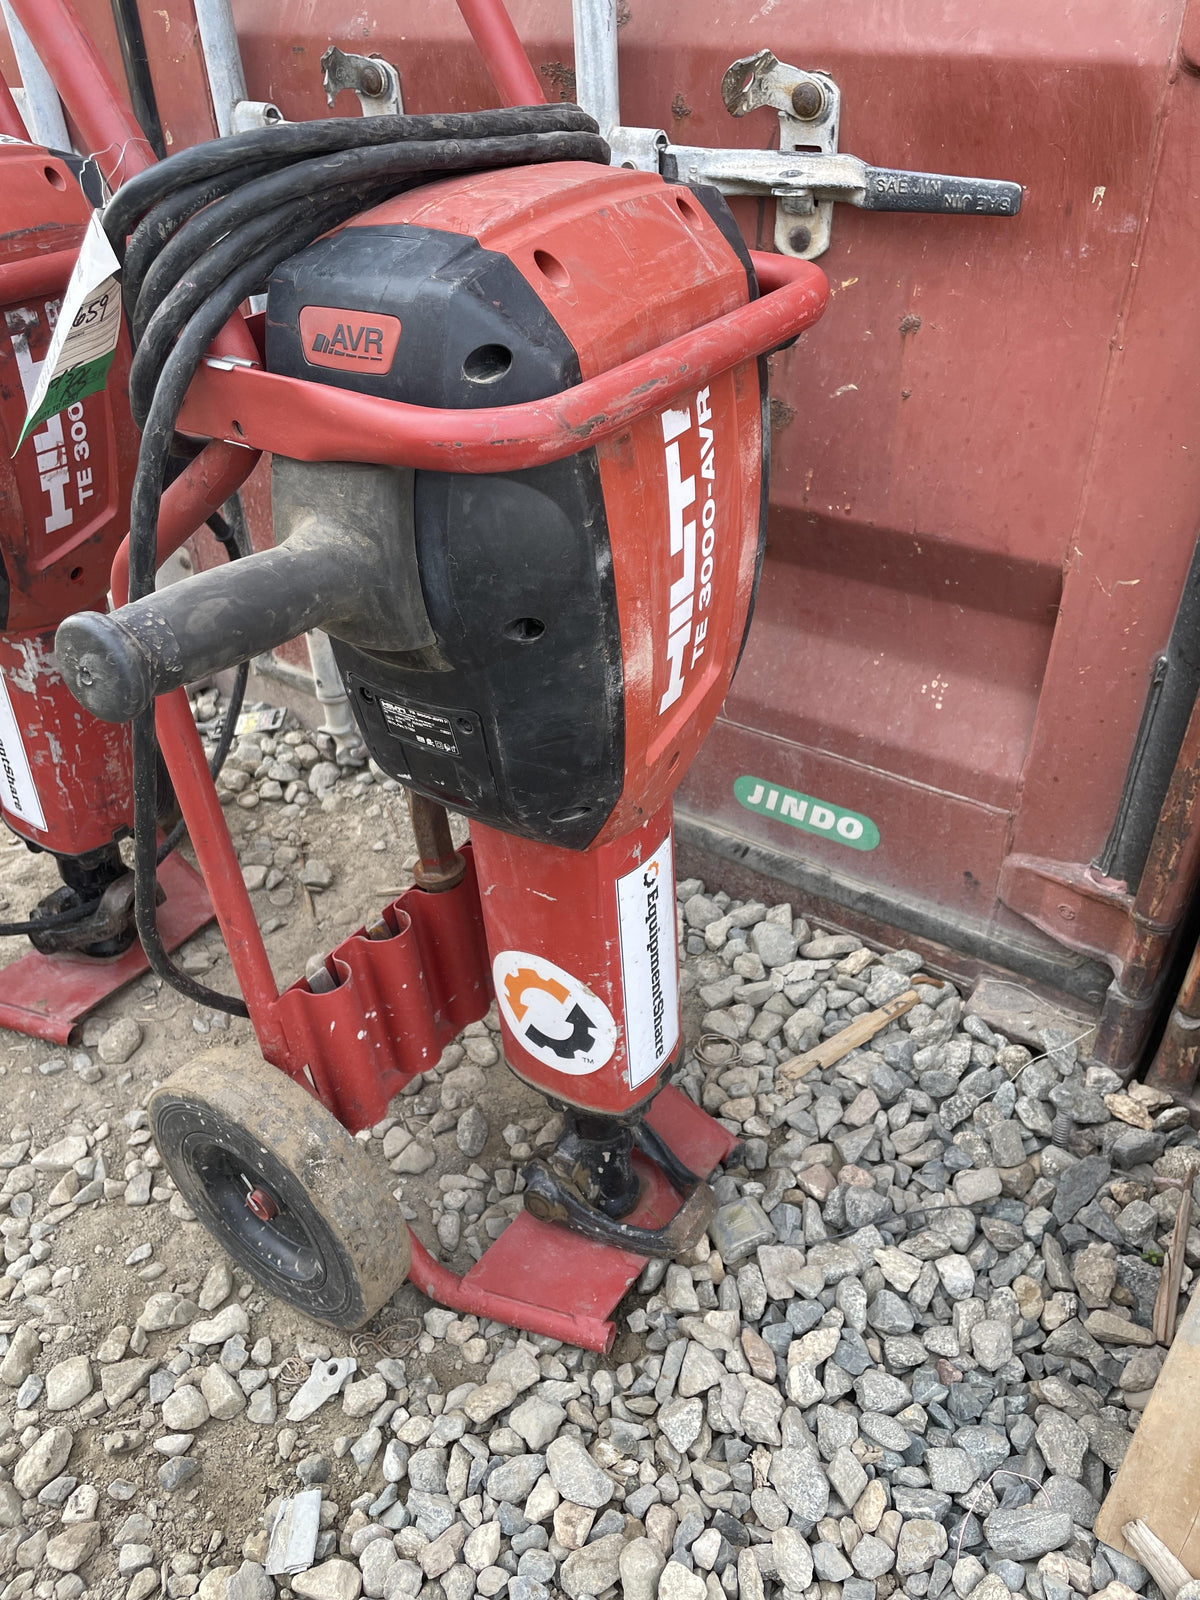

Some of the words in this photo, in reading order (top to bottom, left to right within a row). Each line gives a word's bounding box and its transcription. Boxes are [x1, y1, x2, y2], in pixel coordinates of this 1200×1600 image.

[876, 178, 908, 195] SAE
[331, 323, 384, 355] AVR
[77, 467, 94, 505] TE
[697, 385, 716, 612] 3000-AVR
[659, 406, 697, 716] HILTI
[691, 616, 709, 670] TE
[747, 784, 864, 840] JINDO
[645, 884, 666, 1060] EquipmentShare
